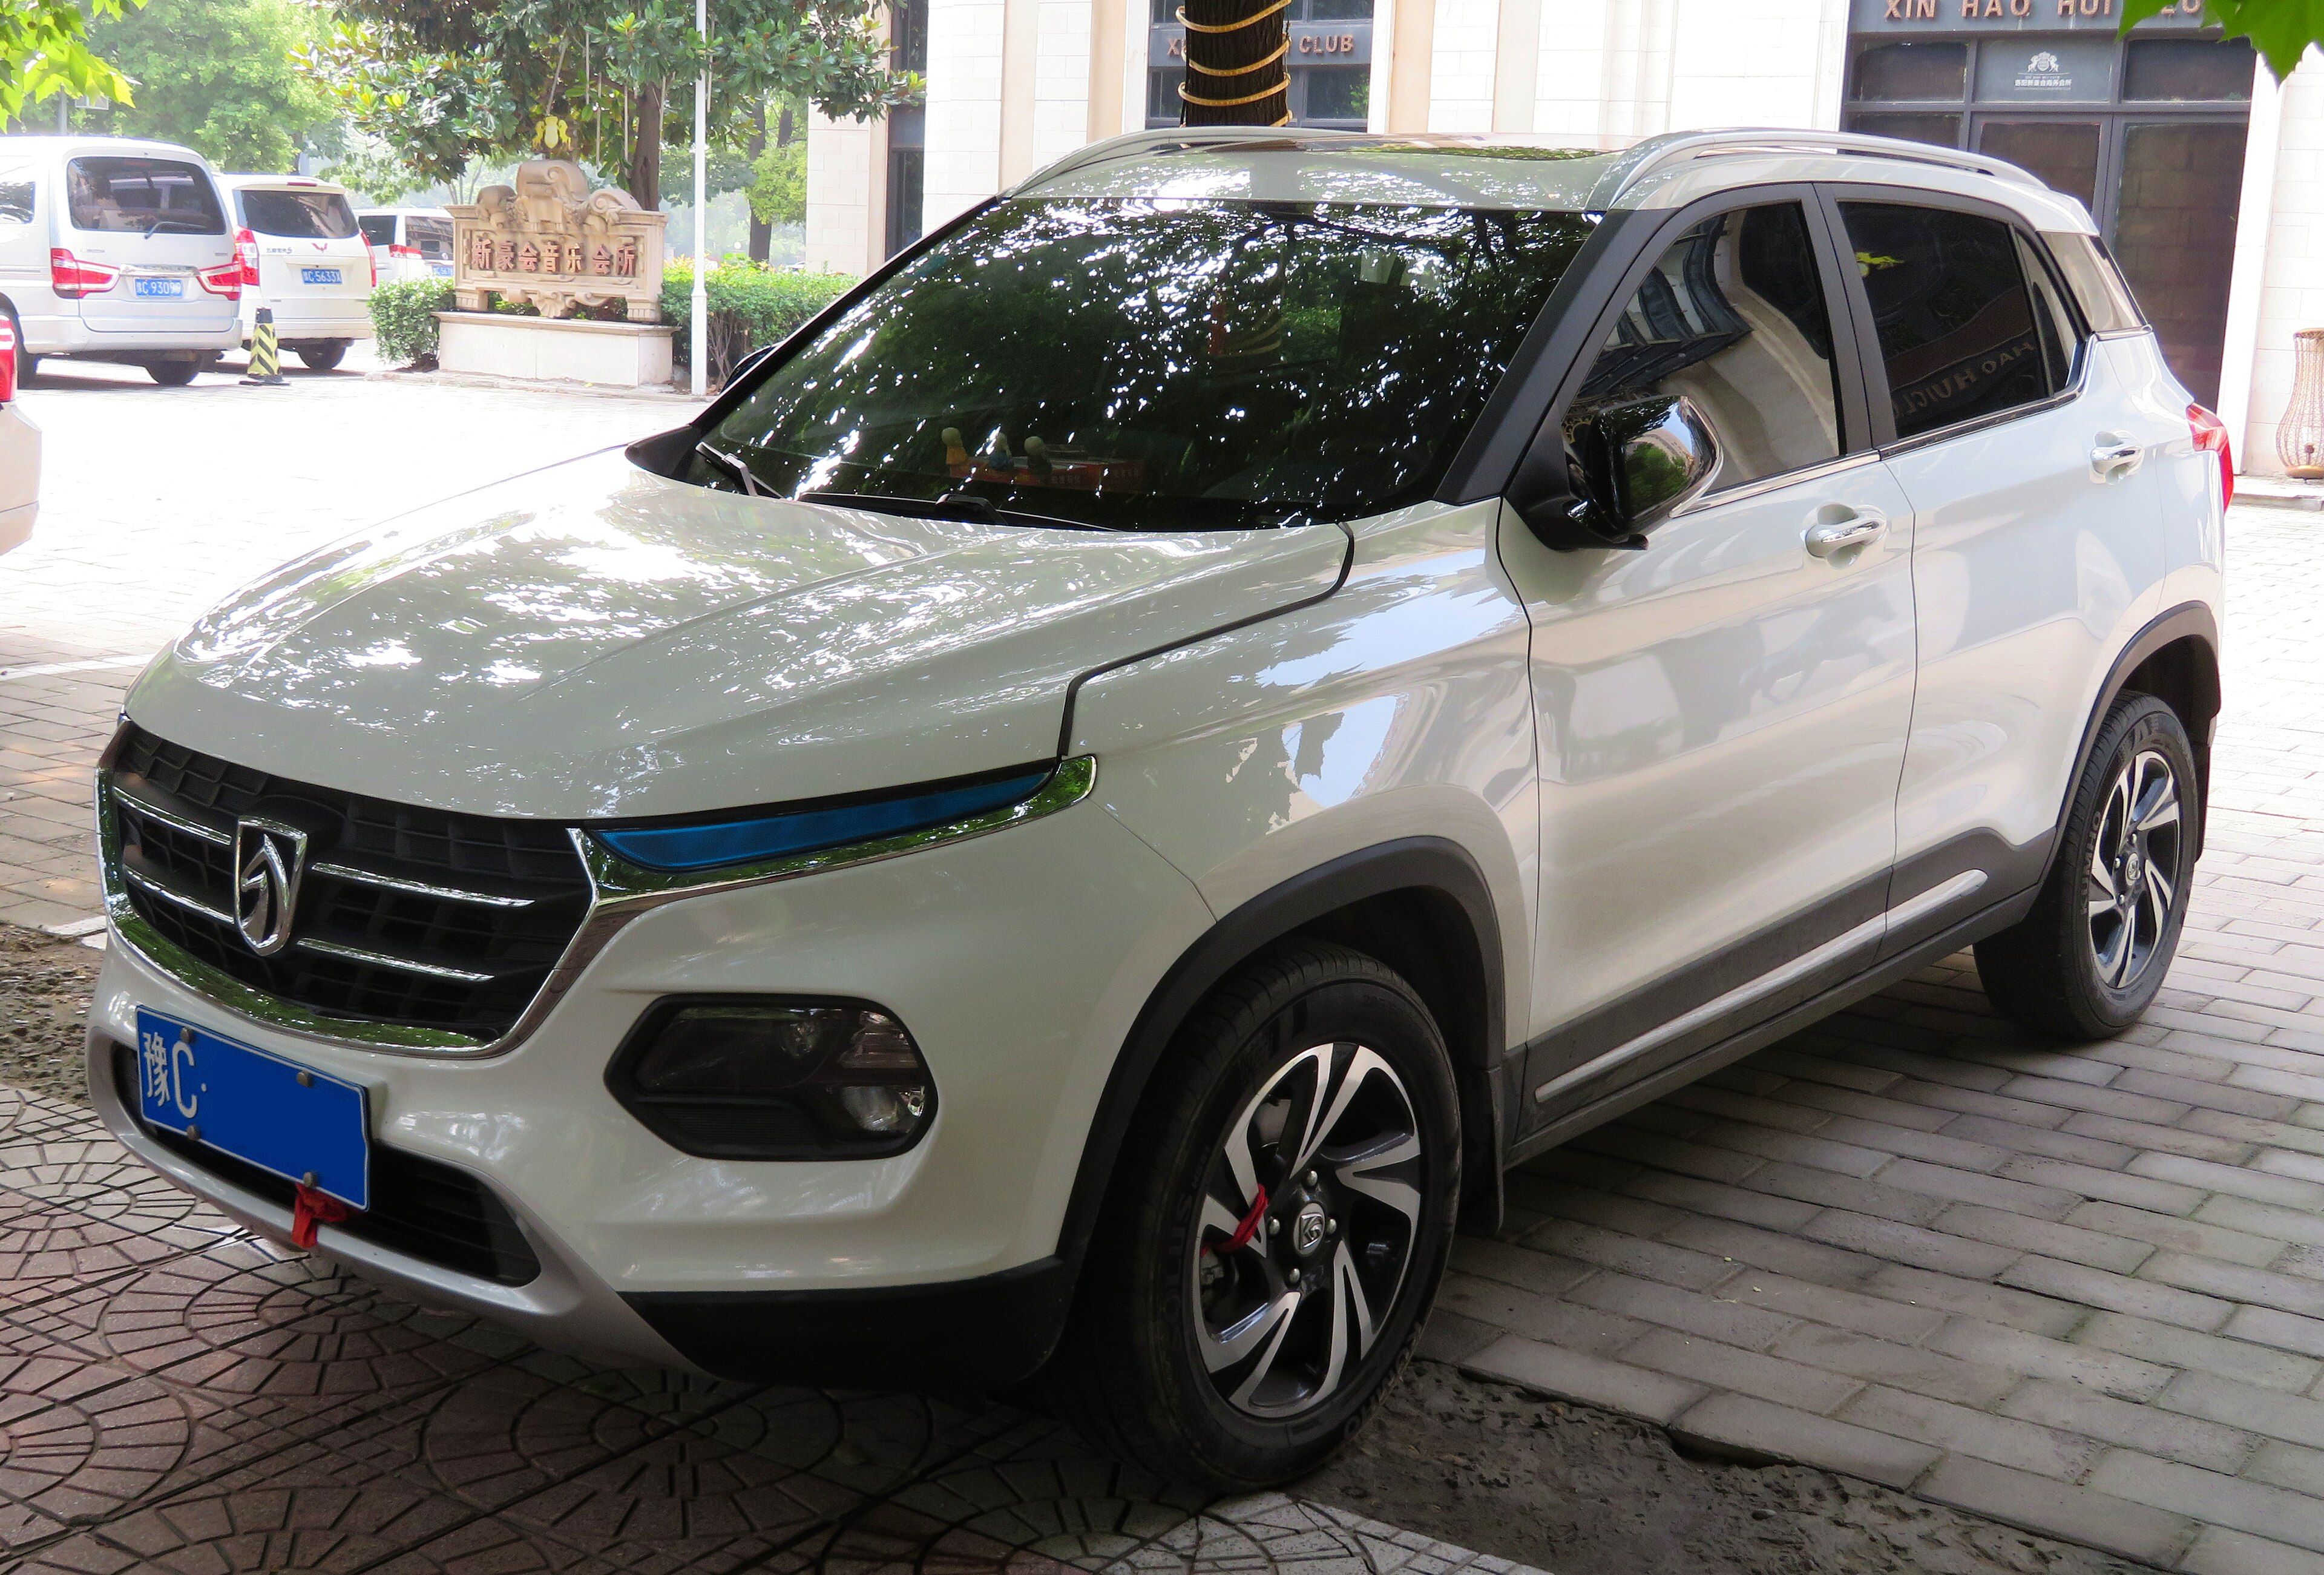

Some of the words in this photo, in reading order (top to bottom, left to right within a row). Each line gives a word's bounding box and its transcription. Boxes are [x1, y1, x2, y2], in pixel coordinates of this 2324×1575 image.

[1884, 0, 1935, 18] XIN
[1961, 0, 2029, 18] HAO
[1299, 35, 1353, 53] CLUB
[471, 238, 635, 275] 新豪会音乐会所
[2080, 811, 2101, 915] KUMHO
